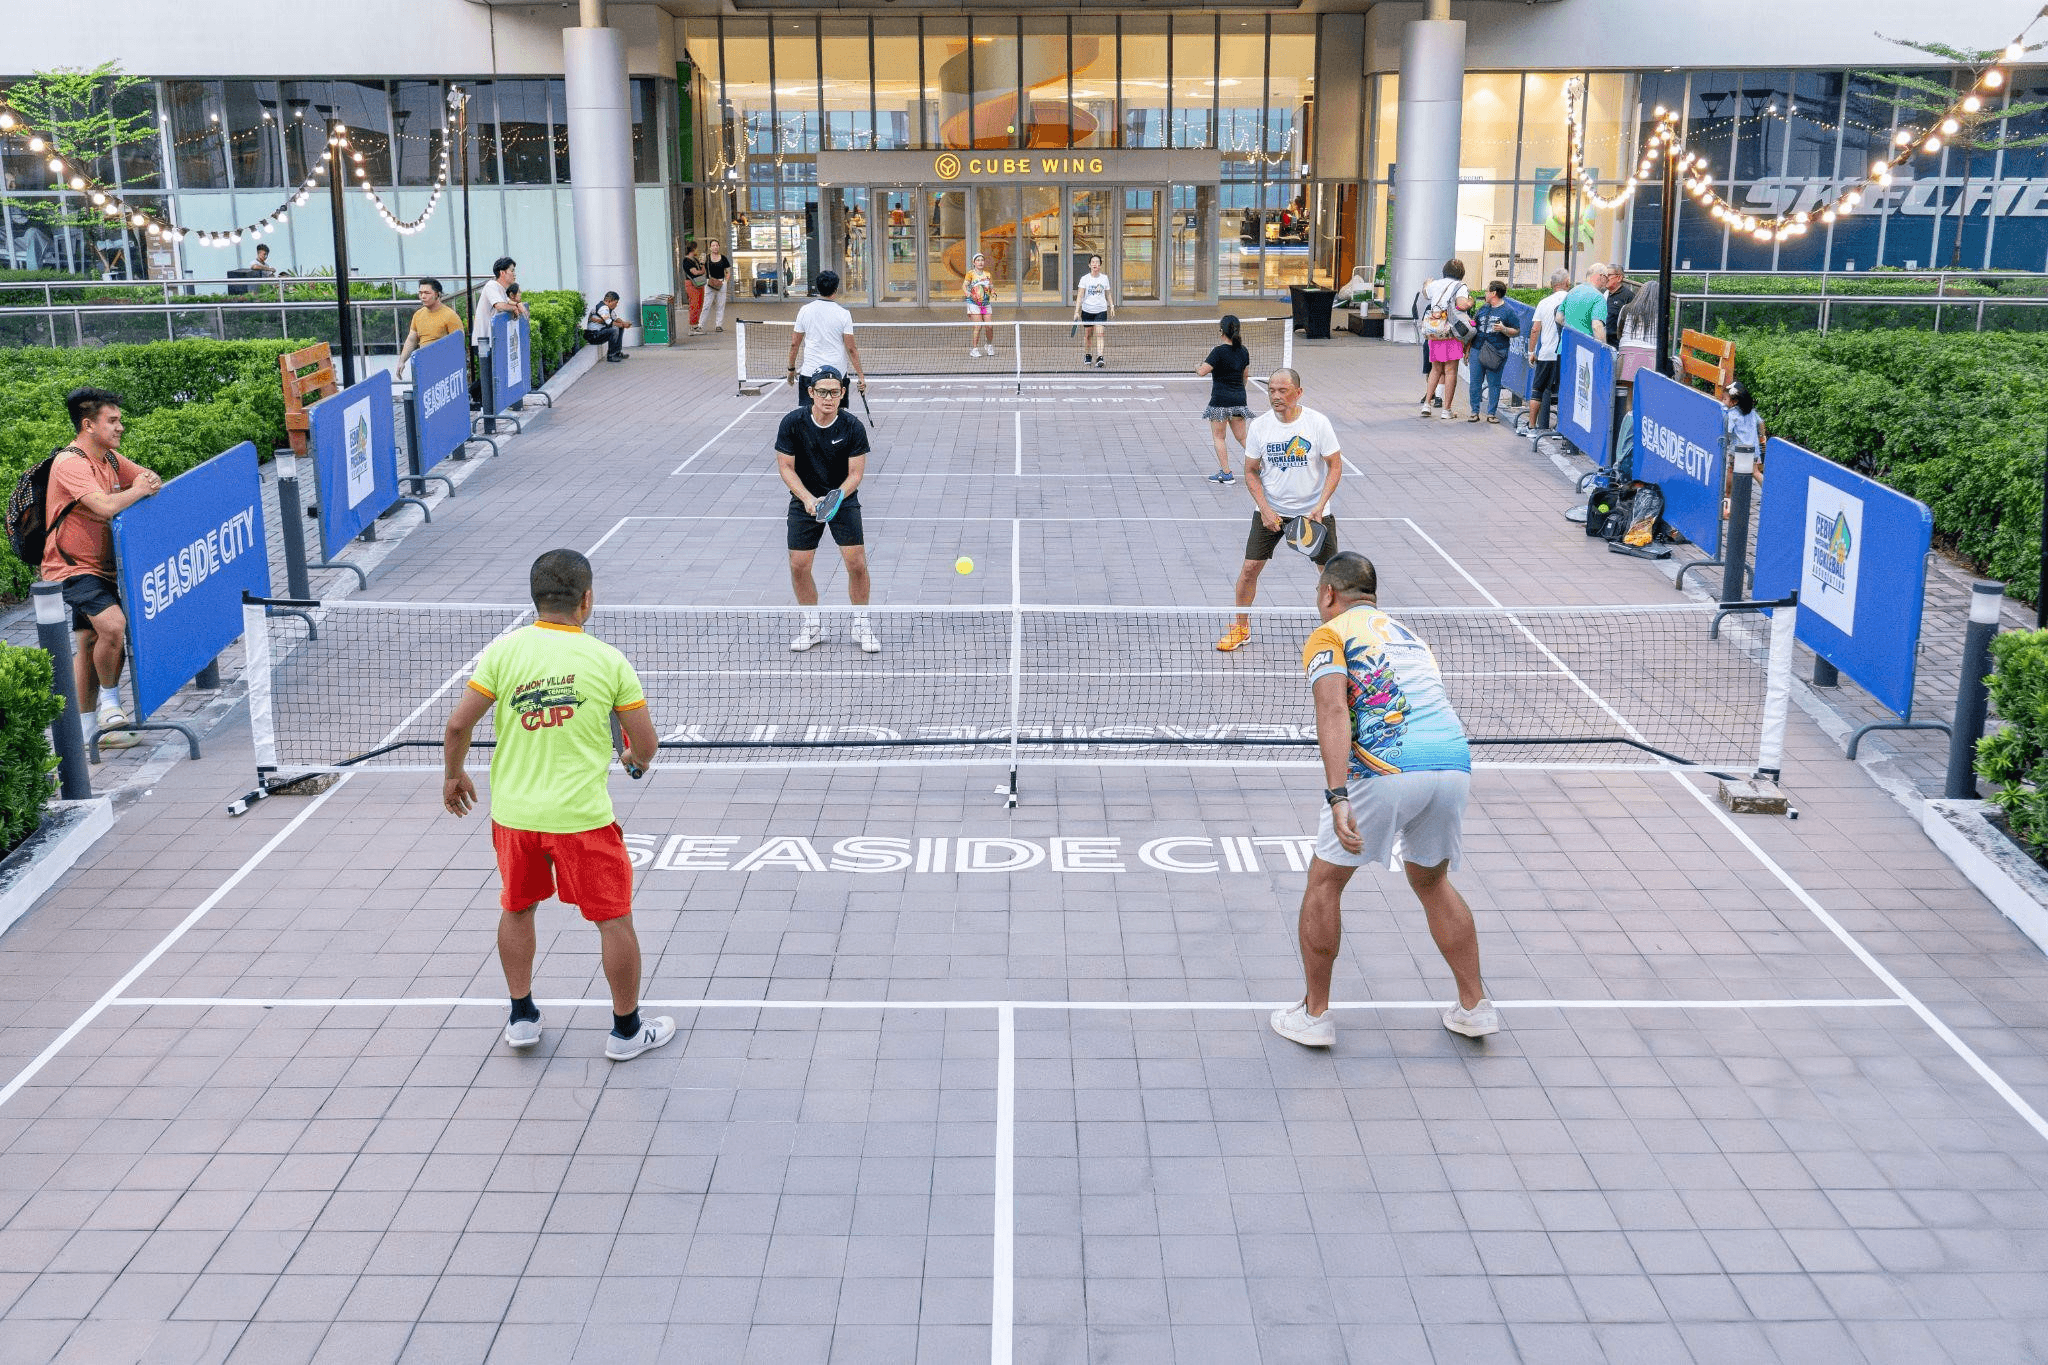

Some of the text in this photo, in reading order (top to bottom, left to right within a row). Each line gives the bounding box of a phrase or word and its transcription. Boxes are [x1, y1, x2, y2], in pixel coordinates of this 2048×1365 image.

[969, 158, 1104, 174] CUBE WING
[423, 367, 464, 419] SEASIDE CITY
[1266, 442, 1289, 452] CEBU
[1267, 455, 1308, 463] PICKLEBALL
[1641, 415, 1714, 486] SEASIDE CITY
[1815, 514, 1835, 541] CEBU
[142, 505, 254, 620] SEASIDE CITY
[1813, 545, 1846, 580] PICKLEBALL
[546, 673, 576, 687] VILLAGE
[520, 705, 575, 731] CUP
[643, 1028, 657, 1043] N
